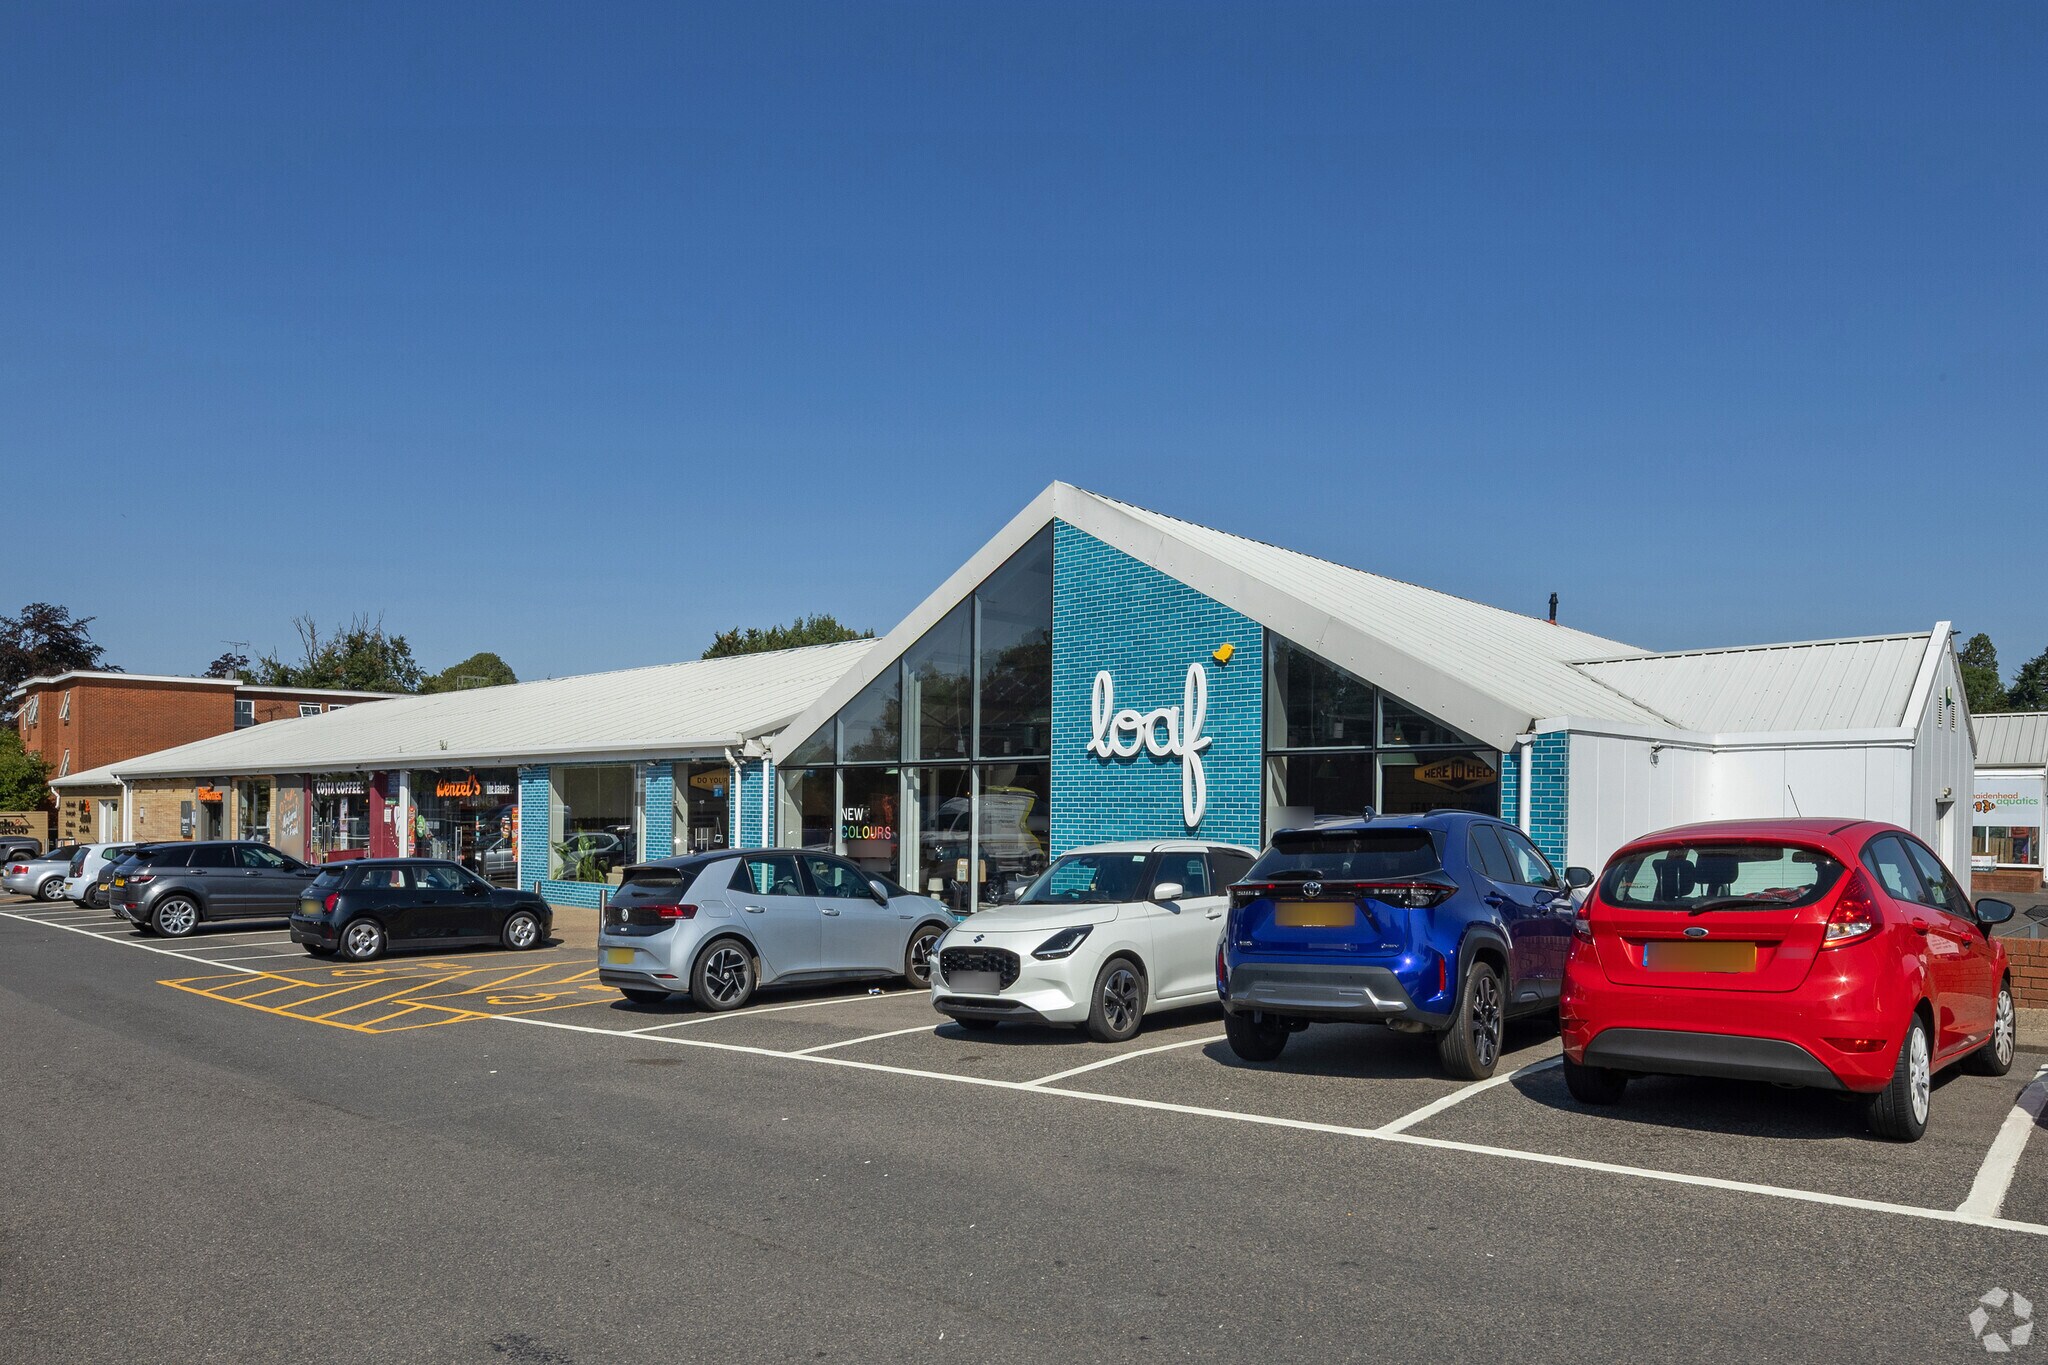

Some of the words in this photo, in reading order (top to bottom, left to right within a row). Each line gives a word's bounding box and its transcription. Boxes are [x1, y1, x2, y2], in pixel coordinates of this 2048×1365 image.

[1087, 662, 1212, 828] loaf
[1424, 766, 1450, 778] HERE
[1453, 763, 1465, 778] TO
[1466, 765, 1495, 777] HELP
[316, 782, 335, 795] COSTA
[336, 781, 361, 795] COFFEE
[436, 775, 481, 798] Wenzel's
[1996, 796, 2038, 806] aquatics
[841, 807, 864, 821] NEW
[840, 825, 892, 840] COLOURS
